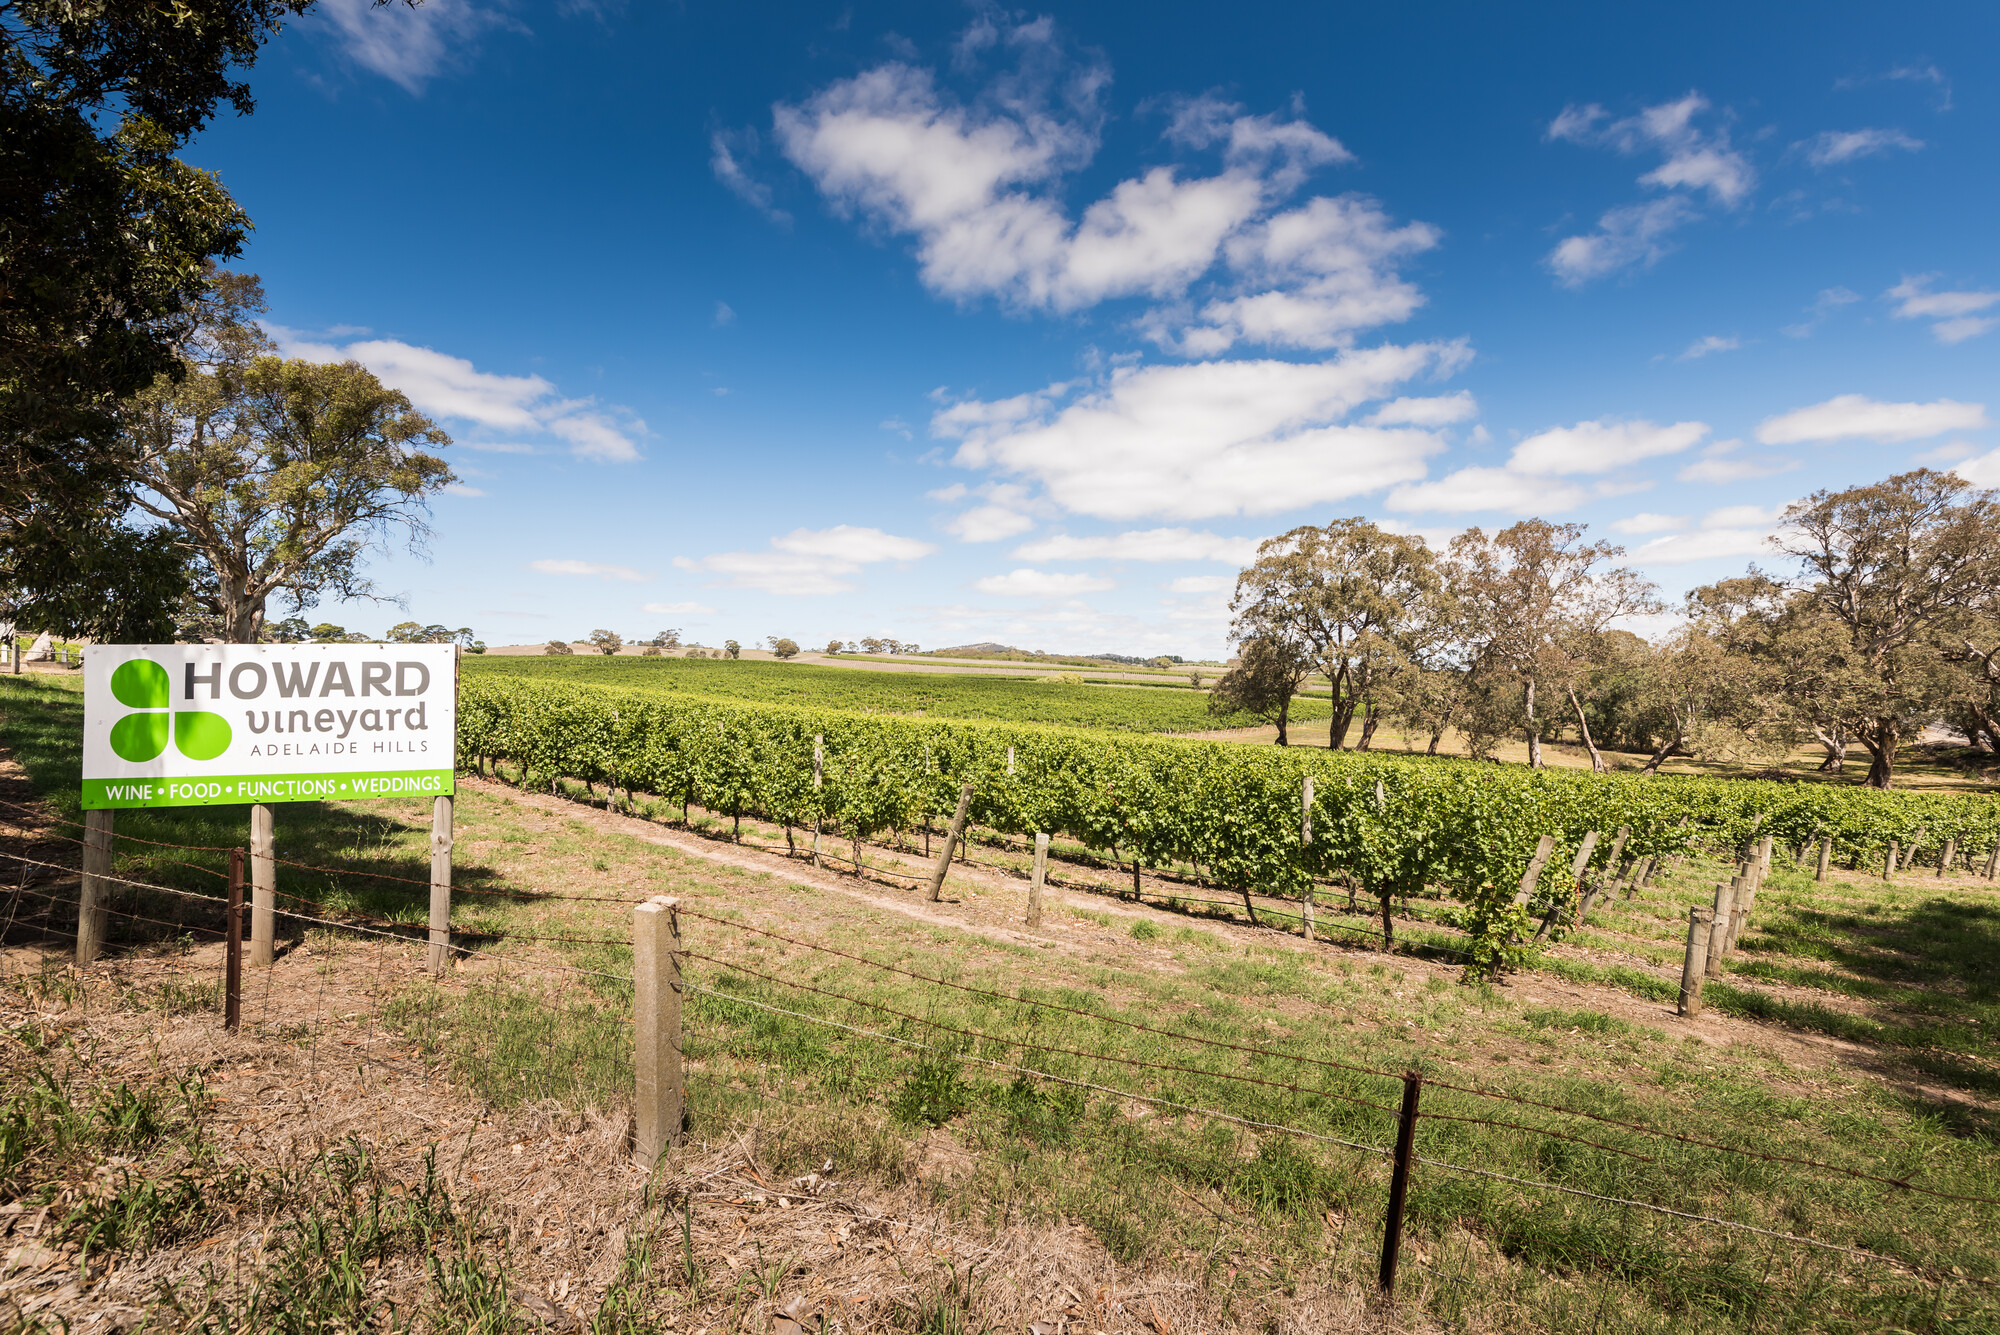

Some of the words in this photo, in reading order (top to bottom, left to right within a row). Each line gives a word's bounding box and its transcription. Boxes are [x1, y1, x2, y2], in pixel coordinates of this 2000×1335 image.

[185, 661, 430, 700] HOWARD
[246, 701, 428, 739] vineyard
[250, 742, 358, 757] ADELAIDE
[373, 740, 428, 753] HILLS
[105, 784, 153, 801] WINE
[170, 782, 221, 798] FOOD
[238, 779, 336, 797] FUNCTIONS
[351, 776, 441, 793] WEDDINGS
